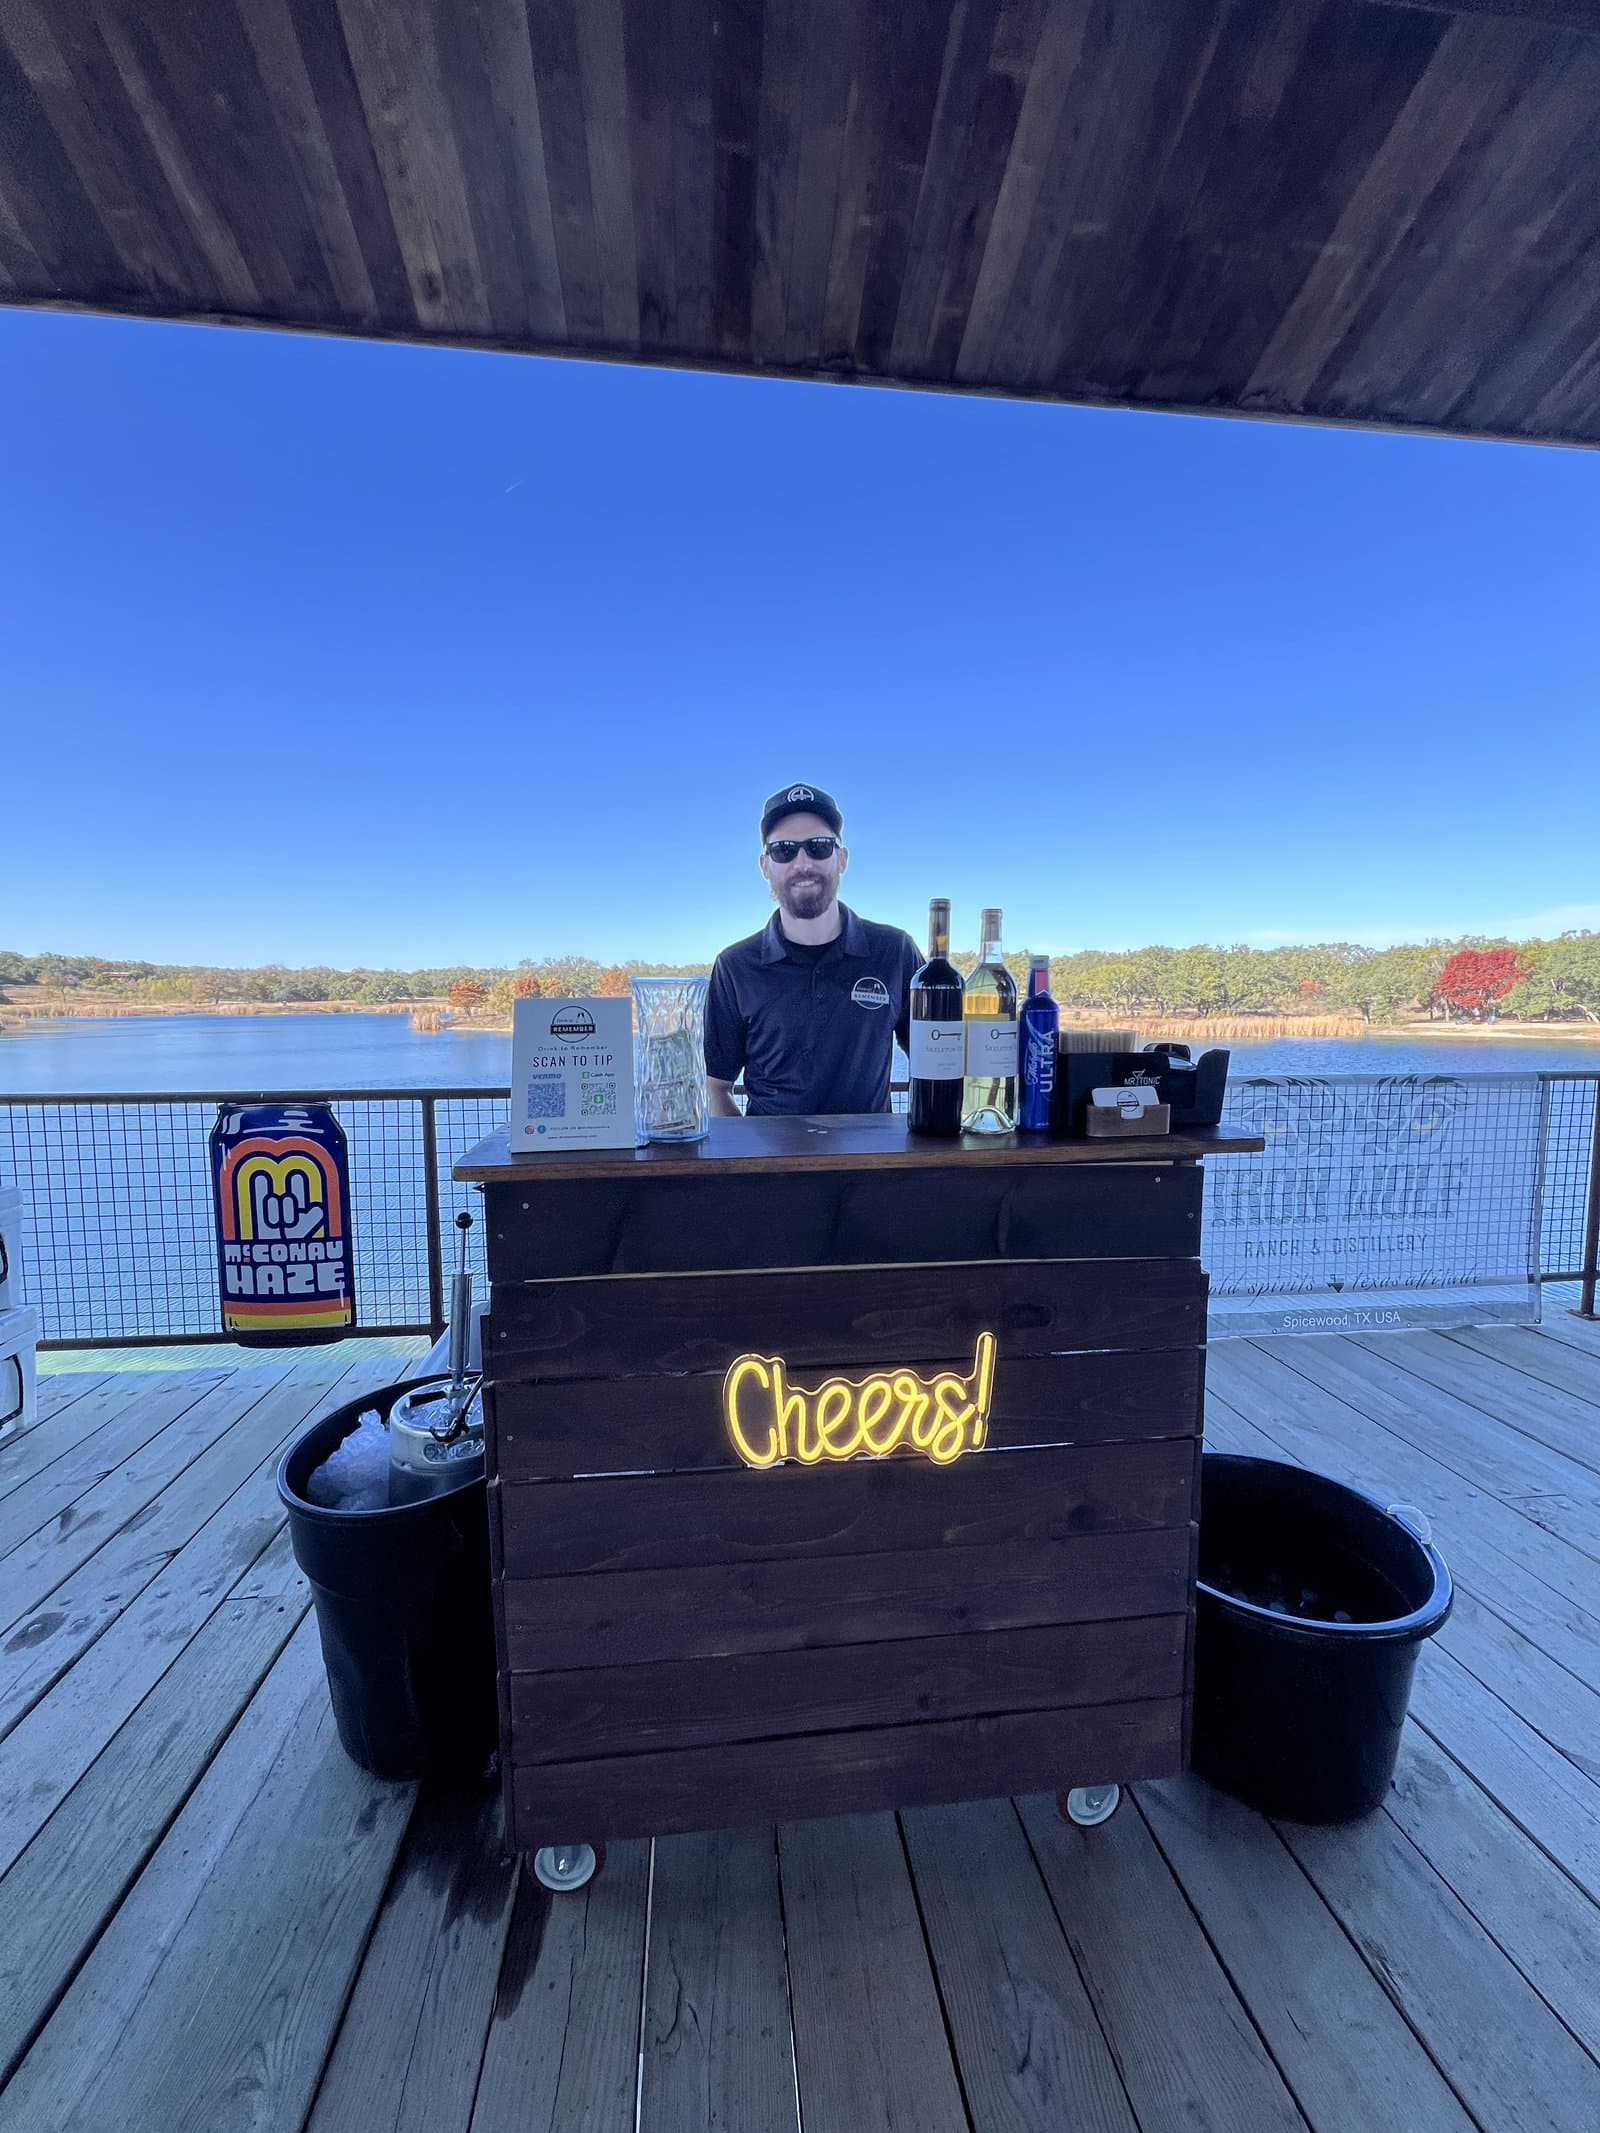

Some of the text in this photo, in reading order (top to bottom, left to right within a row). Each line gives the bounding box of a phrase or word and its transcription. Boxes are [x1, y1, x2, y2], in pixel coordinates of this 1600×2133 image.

[553, 1025, 594, 1033] REMEMBER
[533, 1054, 613, 1068] SCAN TO TIP
[1040, 1030, 1055, 1093] ULTRA
[1244, 1234, 1428, 1259] RANCH & DISTILLERY
[225, 1261, 346, 1295] HAZE
[1247, 1271, 1314, 1307] spirits
[1354, 1312, 1371, 1324] TX
[1375, 1311, 1401, 1323] USA
[728, 1334, 993, 1465] Cheers!
